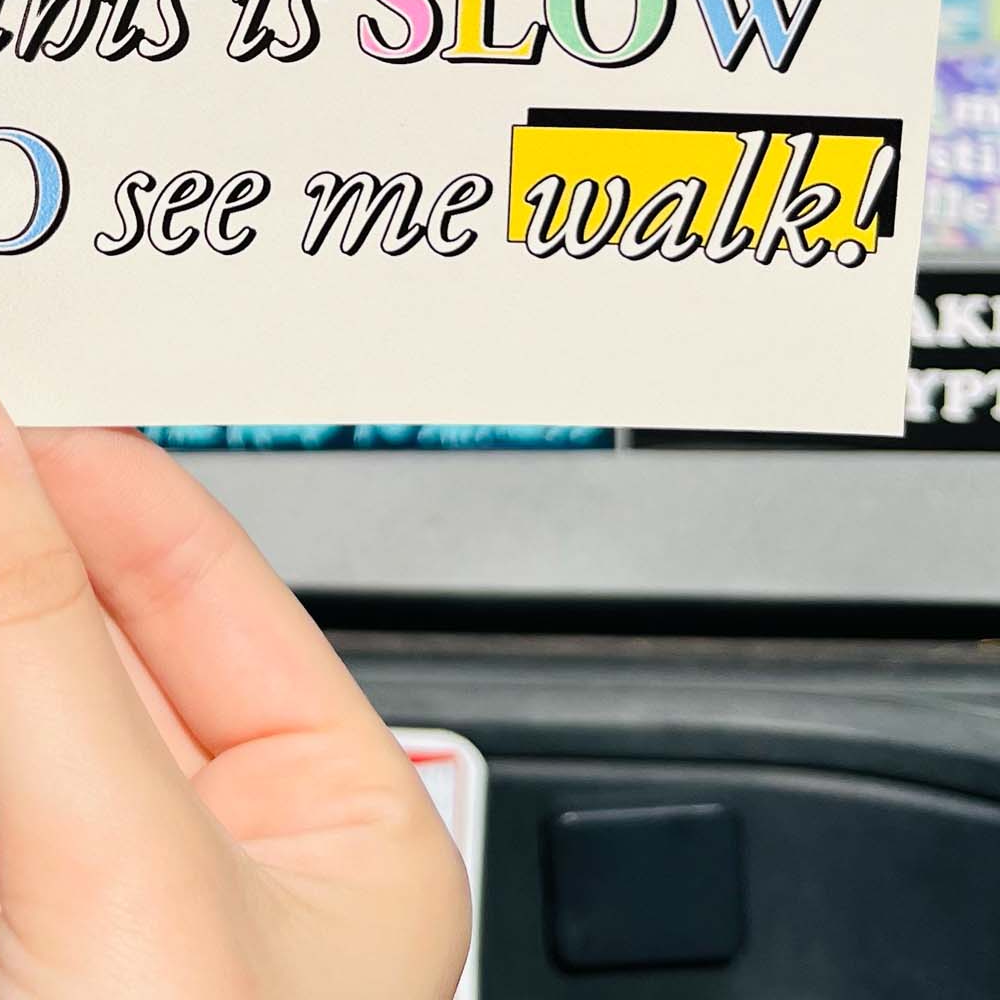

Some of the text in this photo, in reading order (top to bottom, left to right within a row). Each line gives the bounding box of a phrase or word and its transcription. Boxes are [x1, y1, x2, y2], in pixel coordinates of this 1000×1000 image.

[93, 169, 271, 257] see
[301, 170, 493, 258] me
[524, 130, 898, 268] walk!
